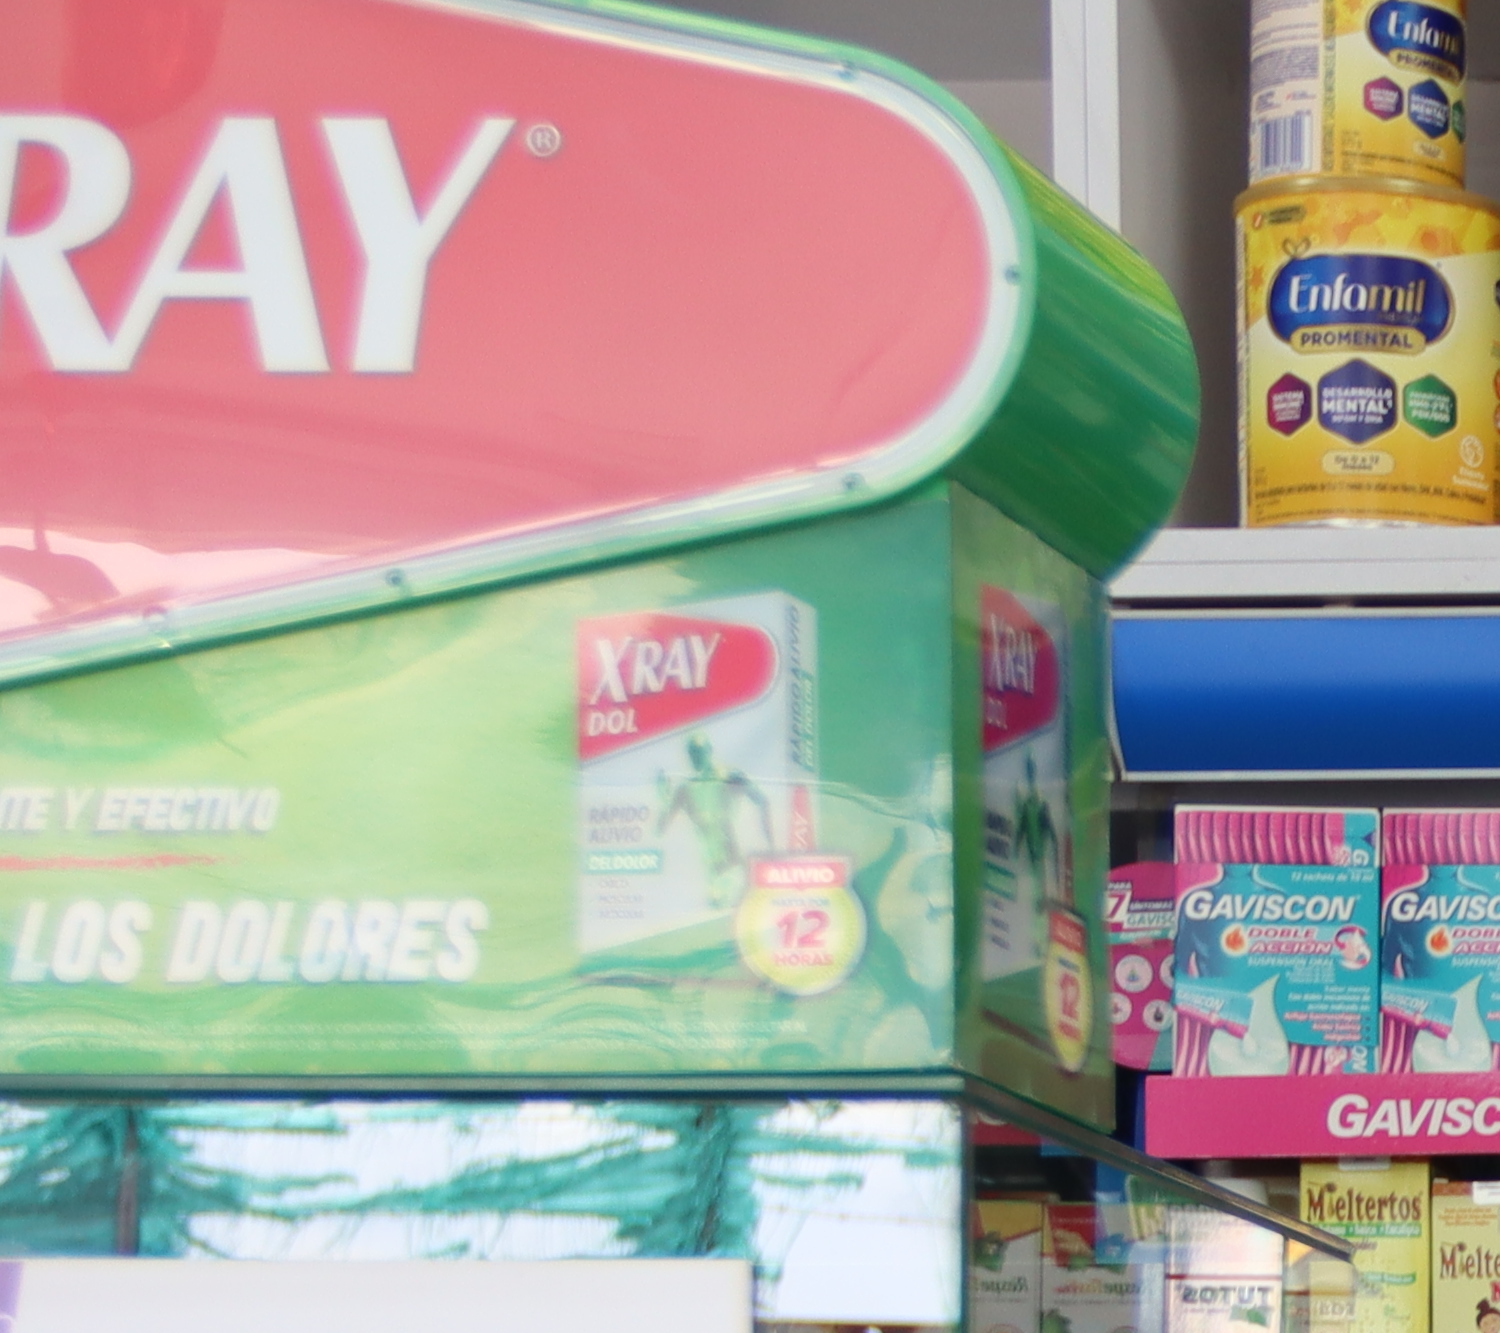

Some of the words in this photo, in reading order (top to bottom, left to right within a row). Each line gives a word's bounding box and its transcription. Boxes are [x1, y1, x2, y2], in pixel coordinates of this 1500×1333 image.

[1289, 271, 1426, 315] Enfamil
[1300, 329, 1415, 351] PROMENTAL
[63, 786, 94, 831] Y
[96, 785, 280, 832] EFECTIVO
[10, 899, 154, 983] LOS
[166, 899, 489, 983] DOLORES
[775, 910, 828, 951] 12
